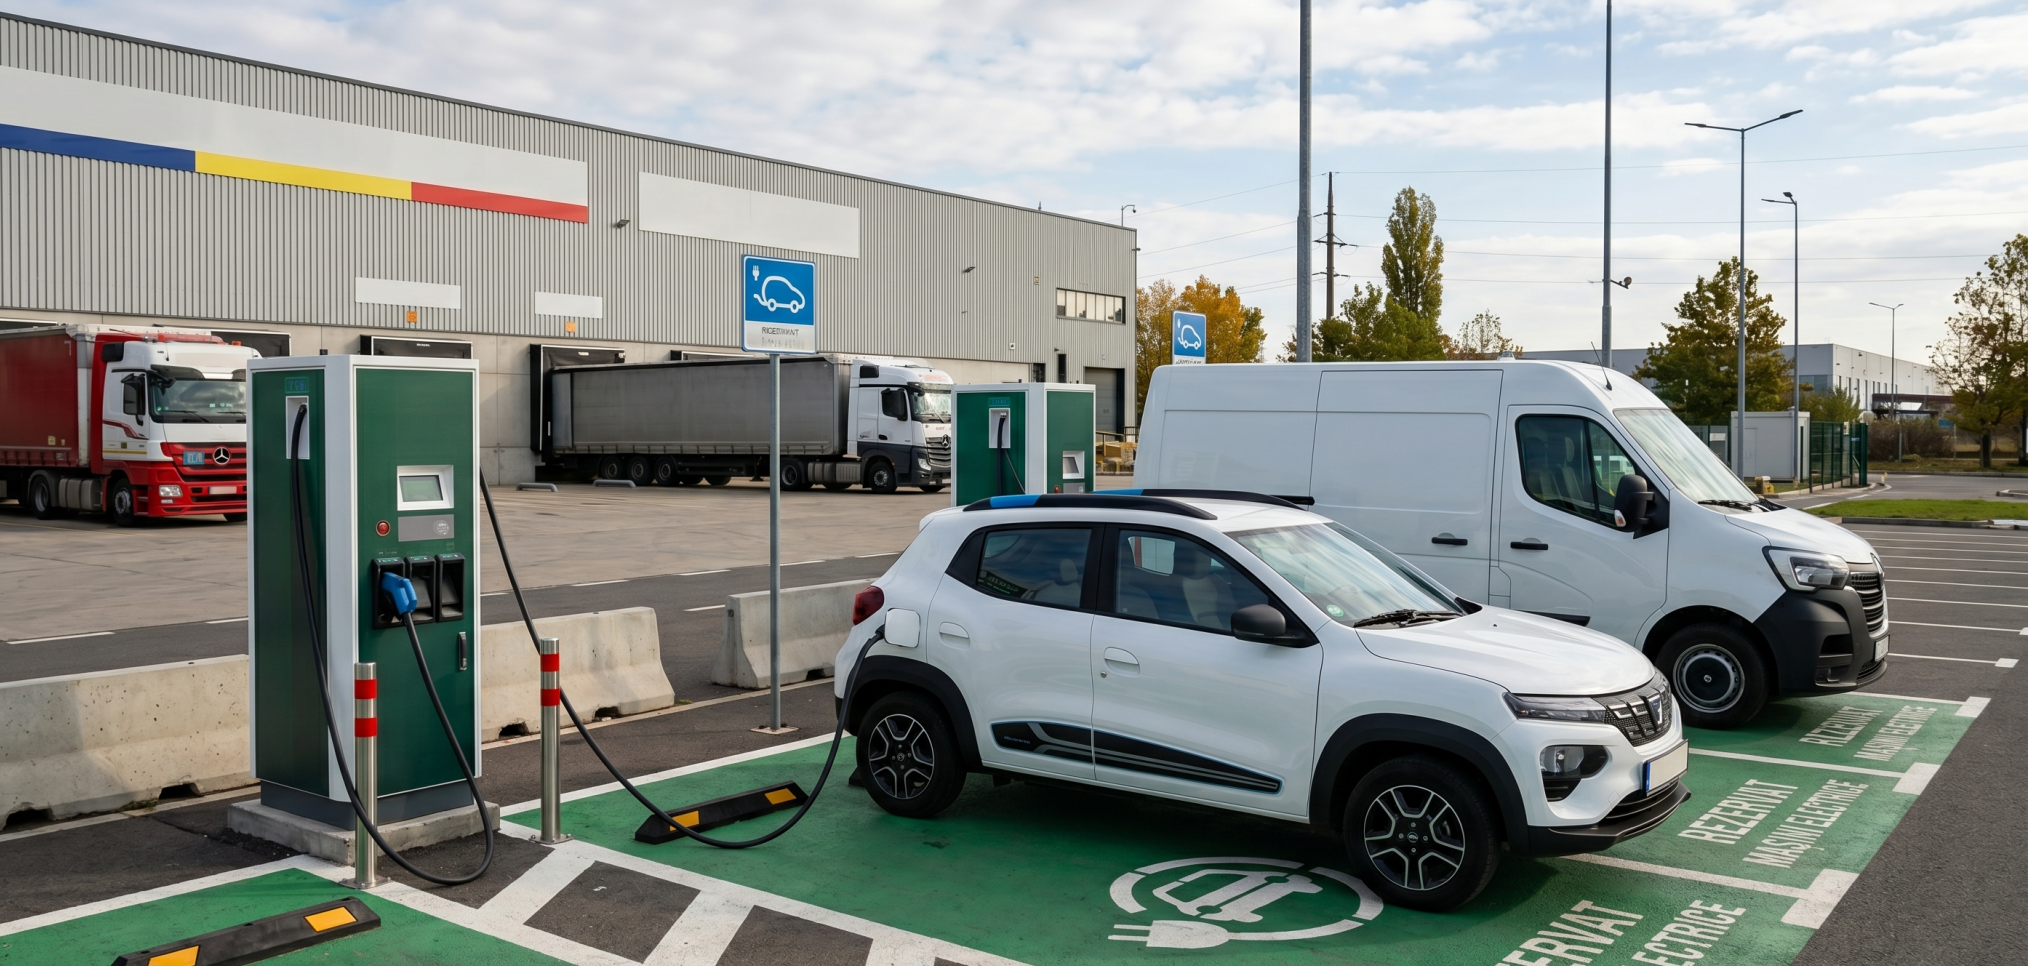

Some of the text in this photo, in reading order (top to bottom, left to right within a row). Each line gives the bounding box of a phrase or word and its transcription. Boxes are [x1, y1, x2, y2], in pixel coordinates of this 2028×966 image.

[1677, 778, 1799, 845] REZERVAT
[1785, 779, 1869, 828] ELECTRICE
[1494, 900, 1644, 966] ERVAT
[1621, 900, 1747, 966] ECTRICE
